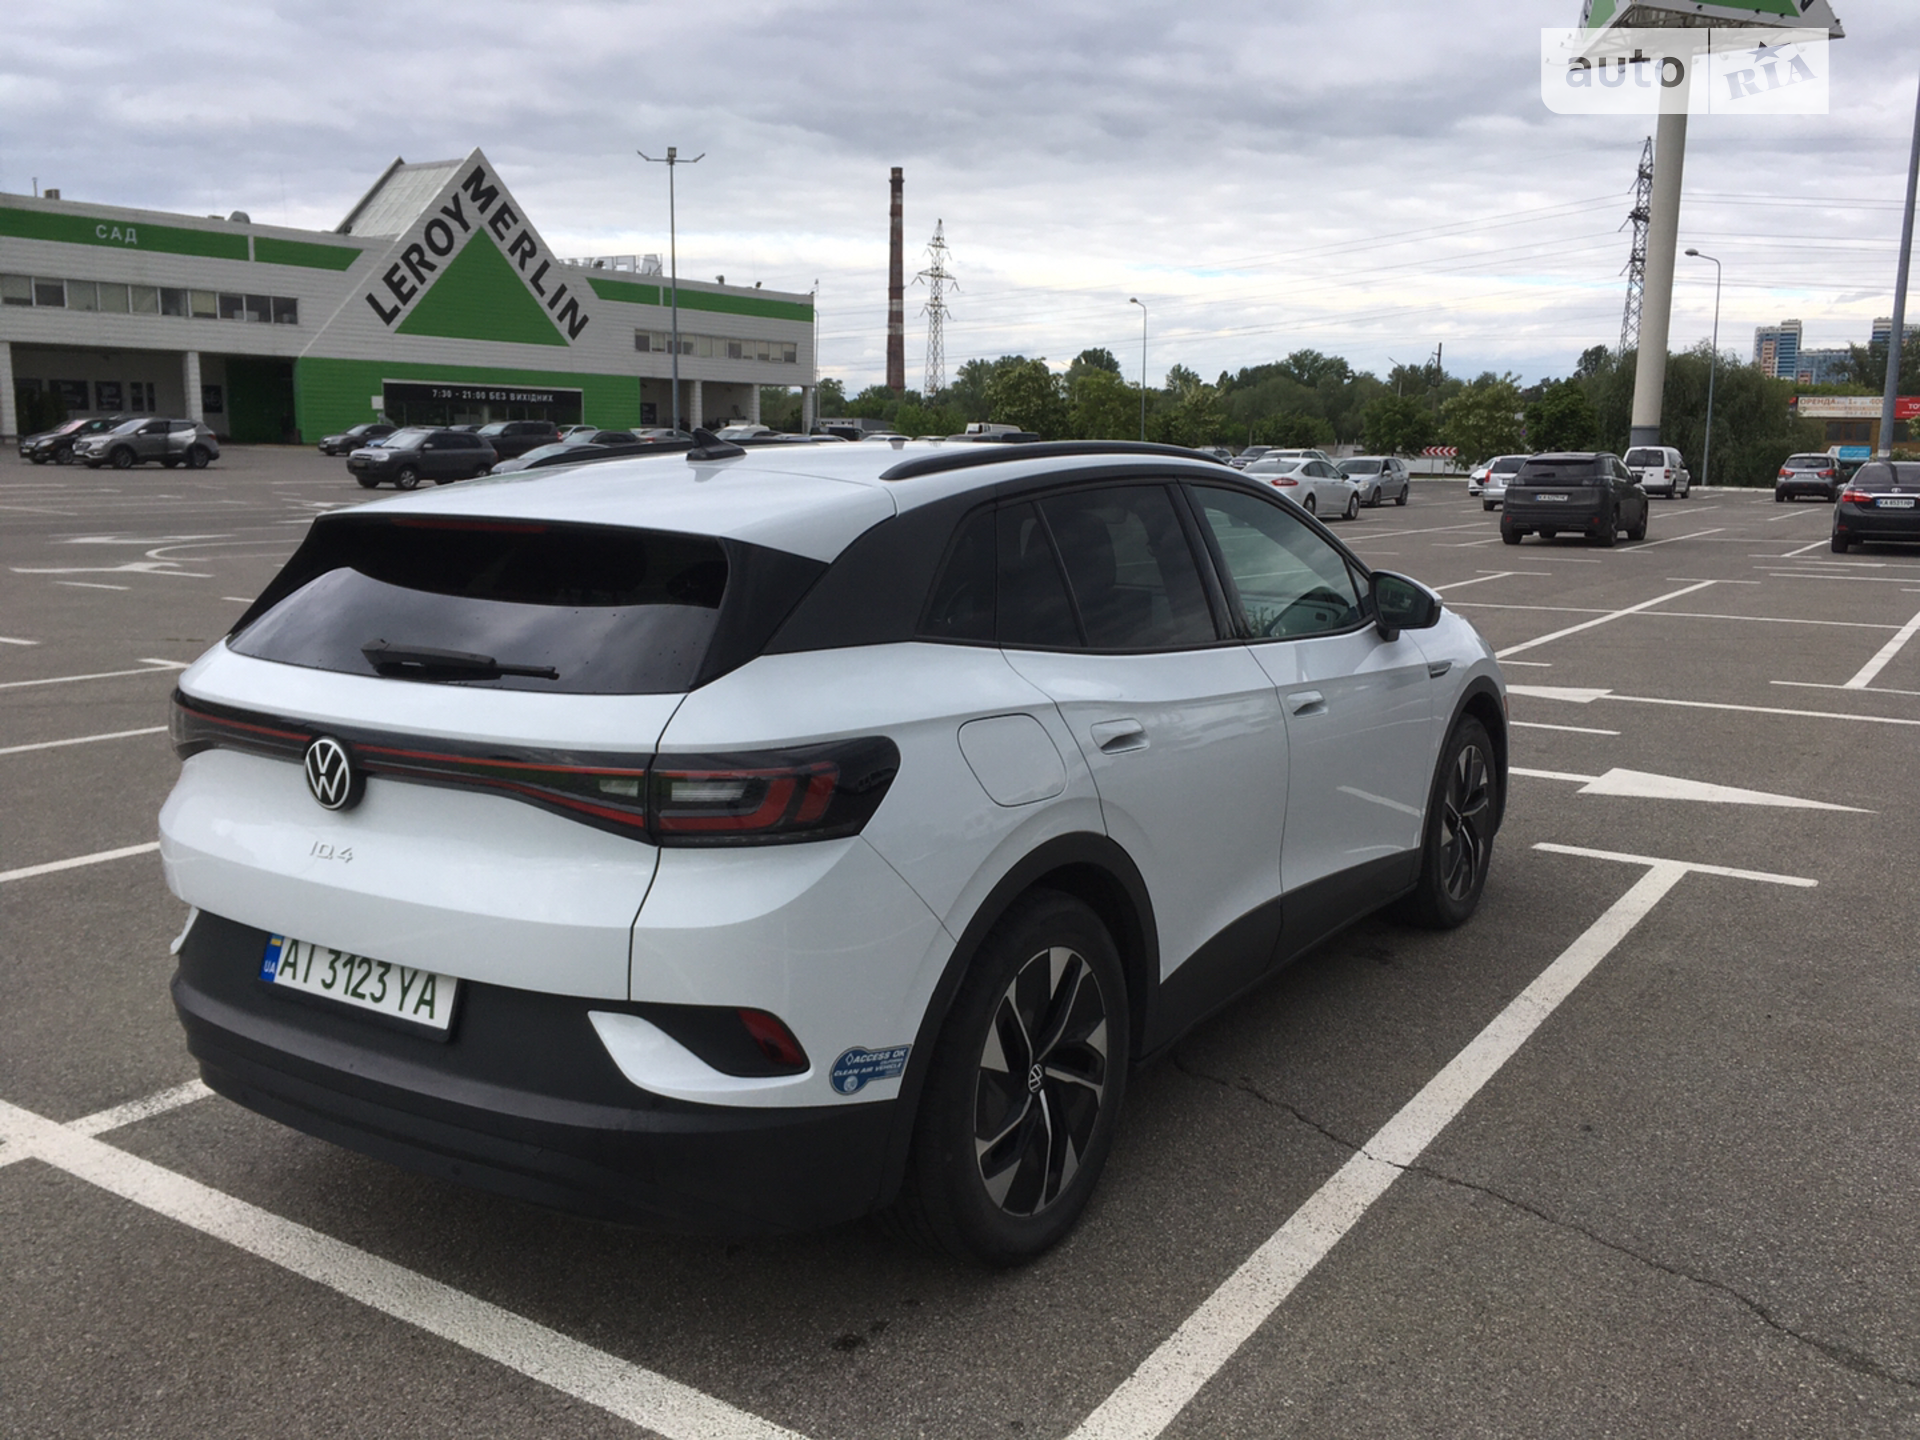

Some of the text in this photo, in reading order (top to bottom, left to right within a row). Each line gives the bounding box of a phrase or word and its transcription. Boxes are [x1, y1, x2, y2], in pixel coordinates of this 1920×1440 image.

[96, 224, 137, 245] САД
[365, 192, 471, 326] LEROY
[461, 165, 589, 341] MERLIN
[432, 389, 452, 398] 7:30
[462, 391, 486, 400] 21:00
[489, 391, 506, 400] БЕЗ
[509, 392, 554, 402] ВИХІДНИХ
[263, 959, 276, 974] UA
[321, 948, 393, 1004] 3123
[398, 965, 438, 1020] YA
[852, 1051, 890, 1064] ACCESS
[834, 1068, 860, 1077] CLEAN
[860, 1066, 874, 1074] AIR
